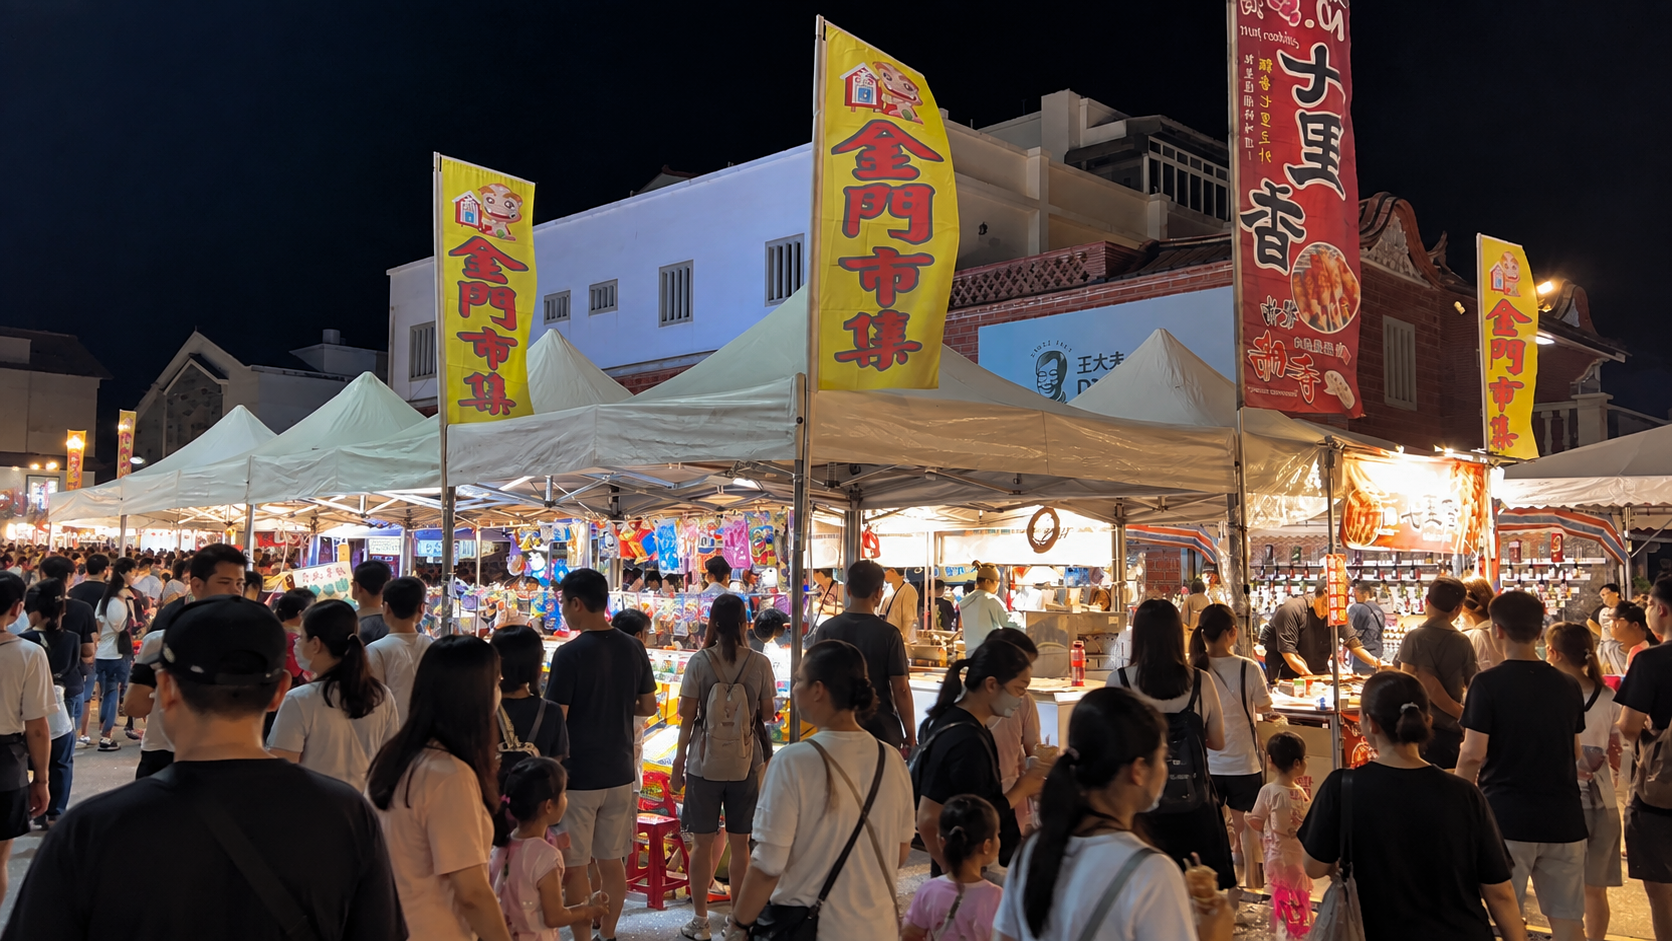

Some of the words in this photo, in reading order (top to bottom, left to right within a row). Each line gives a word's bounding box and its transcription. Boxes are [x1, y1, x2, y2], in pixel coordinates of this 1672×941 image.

[448, 235, 530, 416] 金門市集
[830, 118, 945, 372] 金門市集
[1485, 298, 1533, 450] 金門市集
